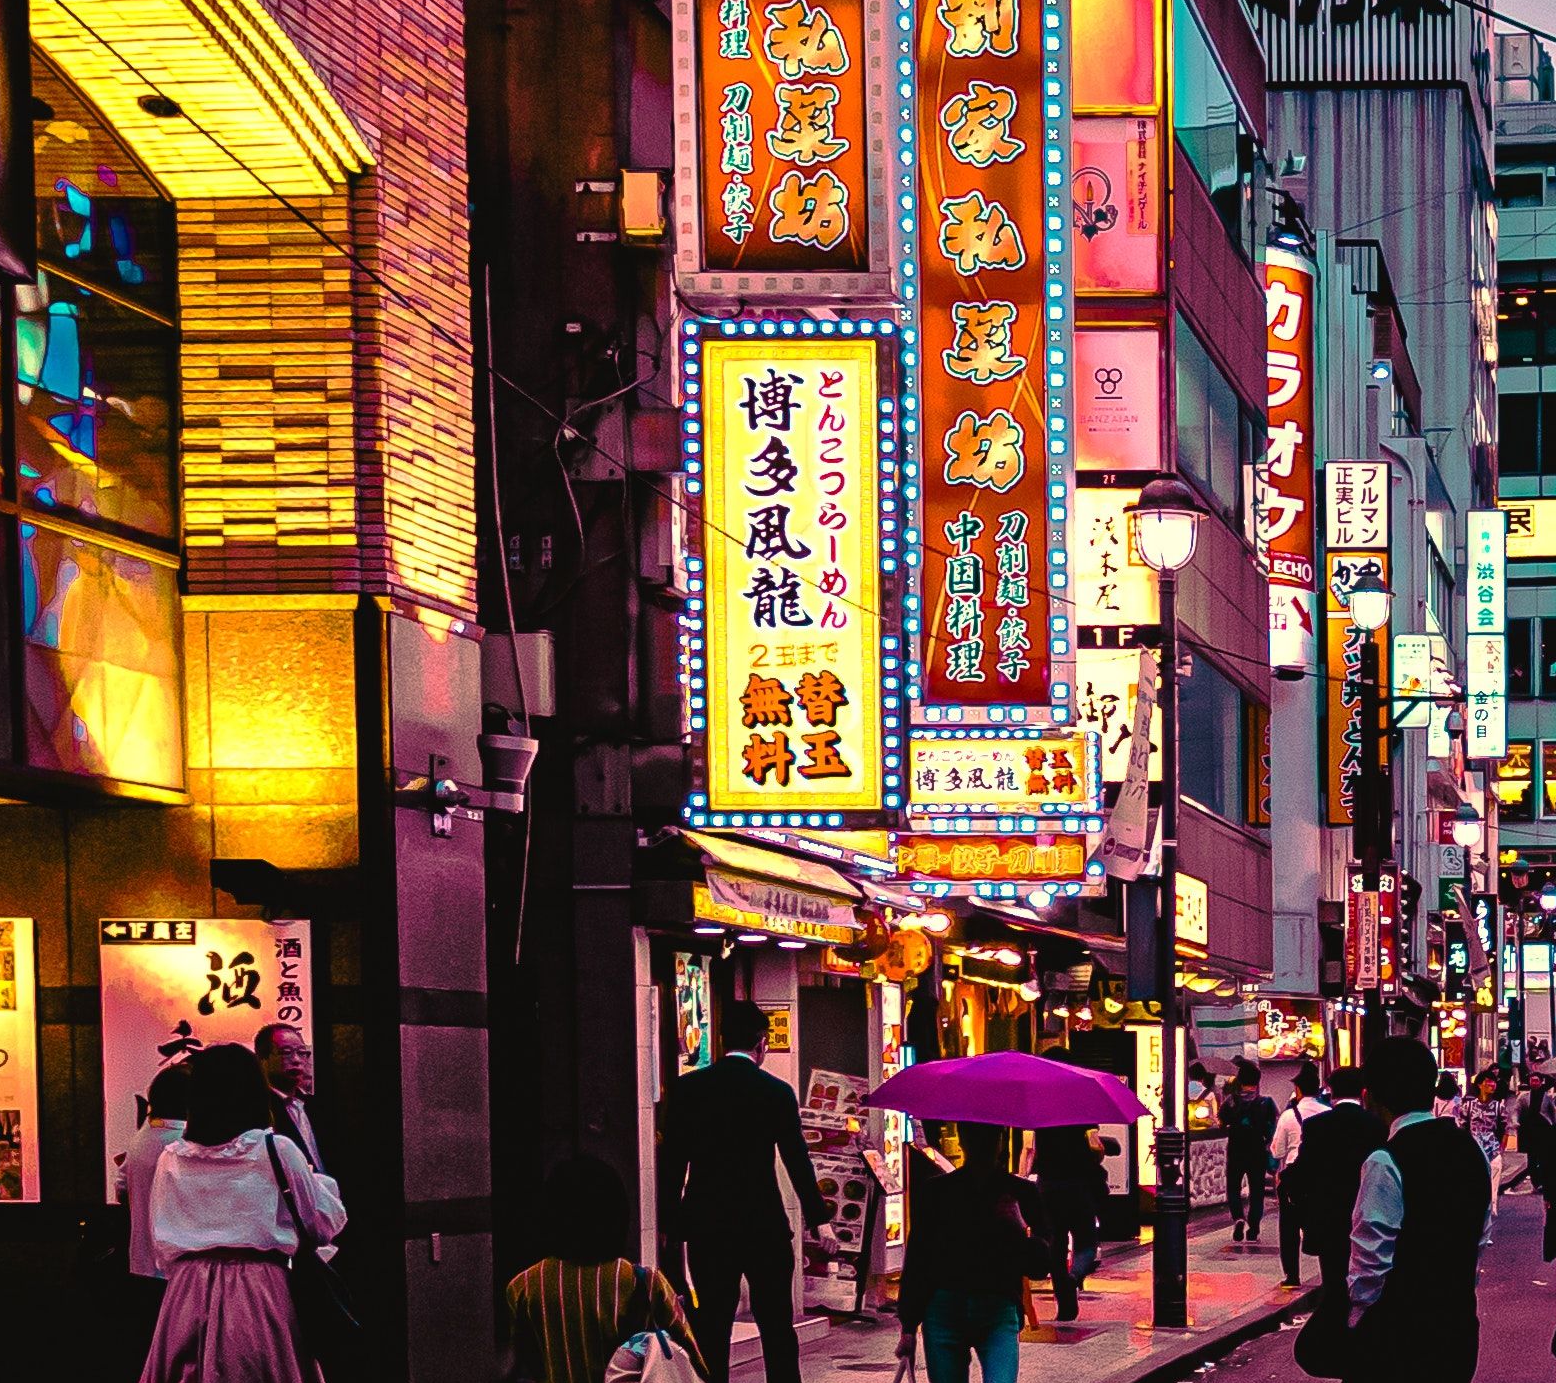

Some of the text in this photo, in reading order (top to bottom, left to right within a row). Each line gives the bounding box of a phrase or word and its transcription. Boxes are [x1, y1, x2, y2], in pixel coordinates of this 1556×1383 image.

[1265, 281, 1306, 542] カラオケ
[740, 367, 814, 630] 博多風龍
[818, 369, 848, 630] とんこつらーめん
[1334, 466, 1355, 545] 正実ビル
[1359, 466, 1379, 545] ブルマン
[943, 512, 986, 683] 中国料理
[1273, 559, 1312, 583] ECHO
[1093, 627, 1133, 646] 1F
[741, 671, 793, 785] 無料
[794, 671, 851, 779] 替玉
[917, 767, 1019, 791] 博多風龍
